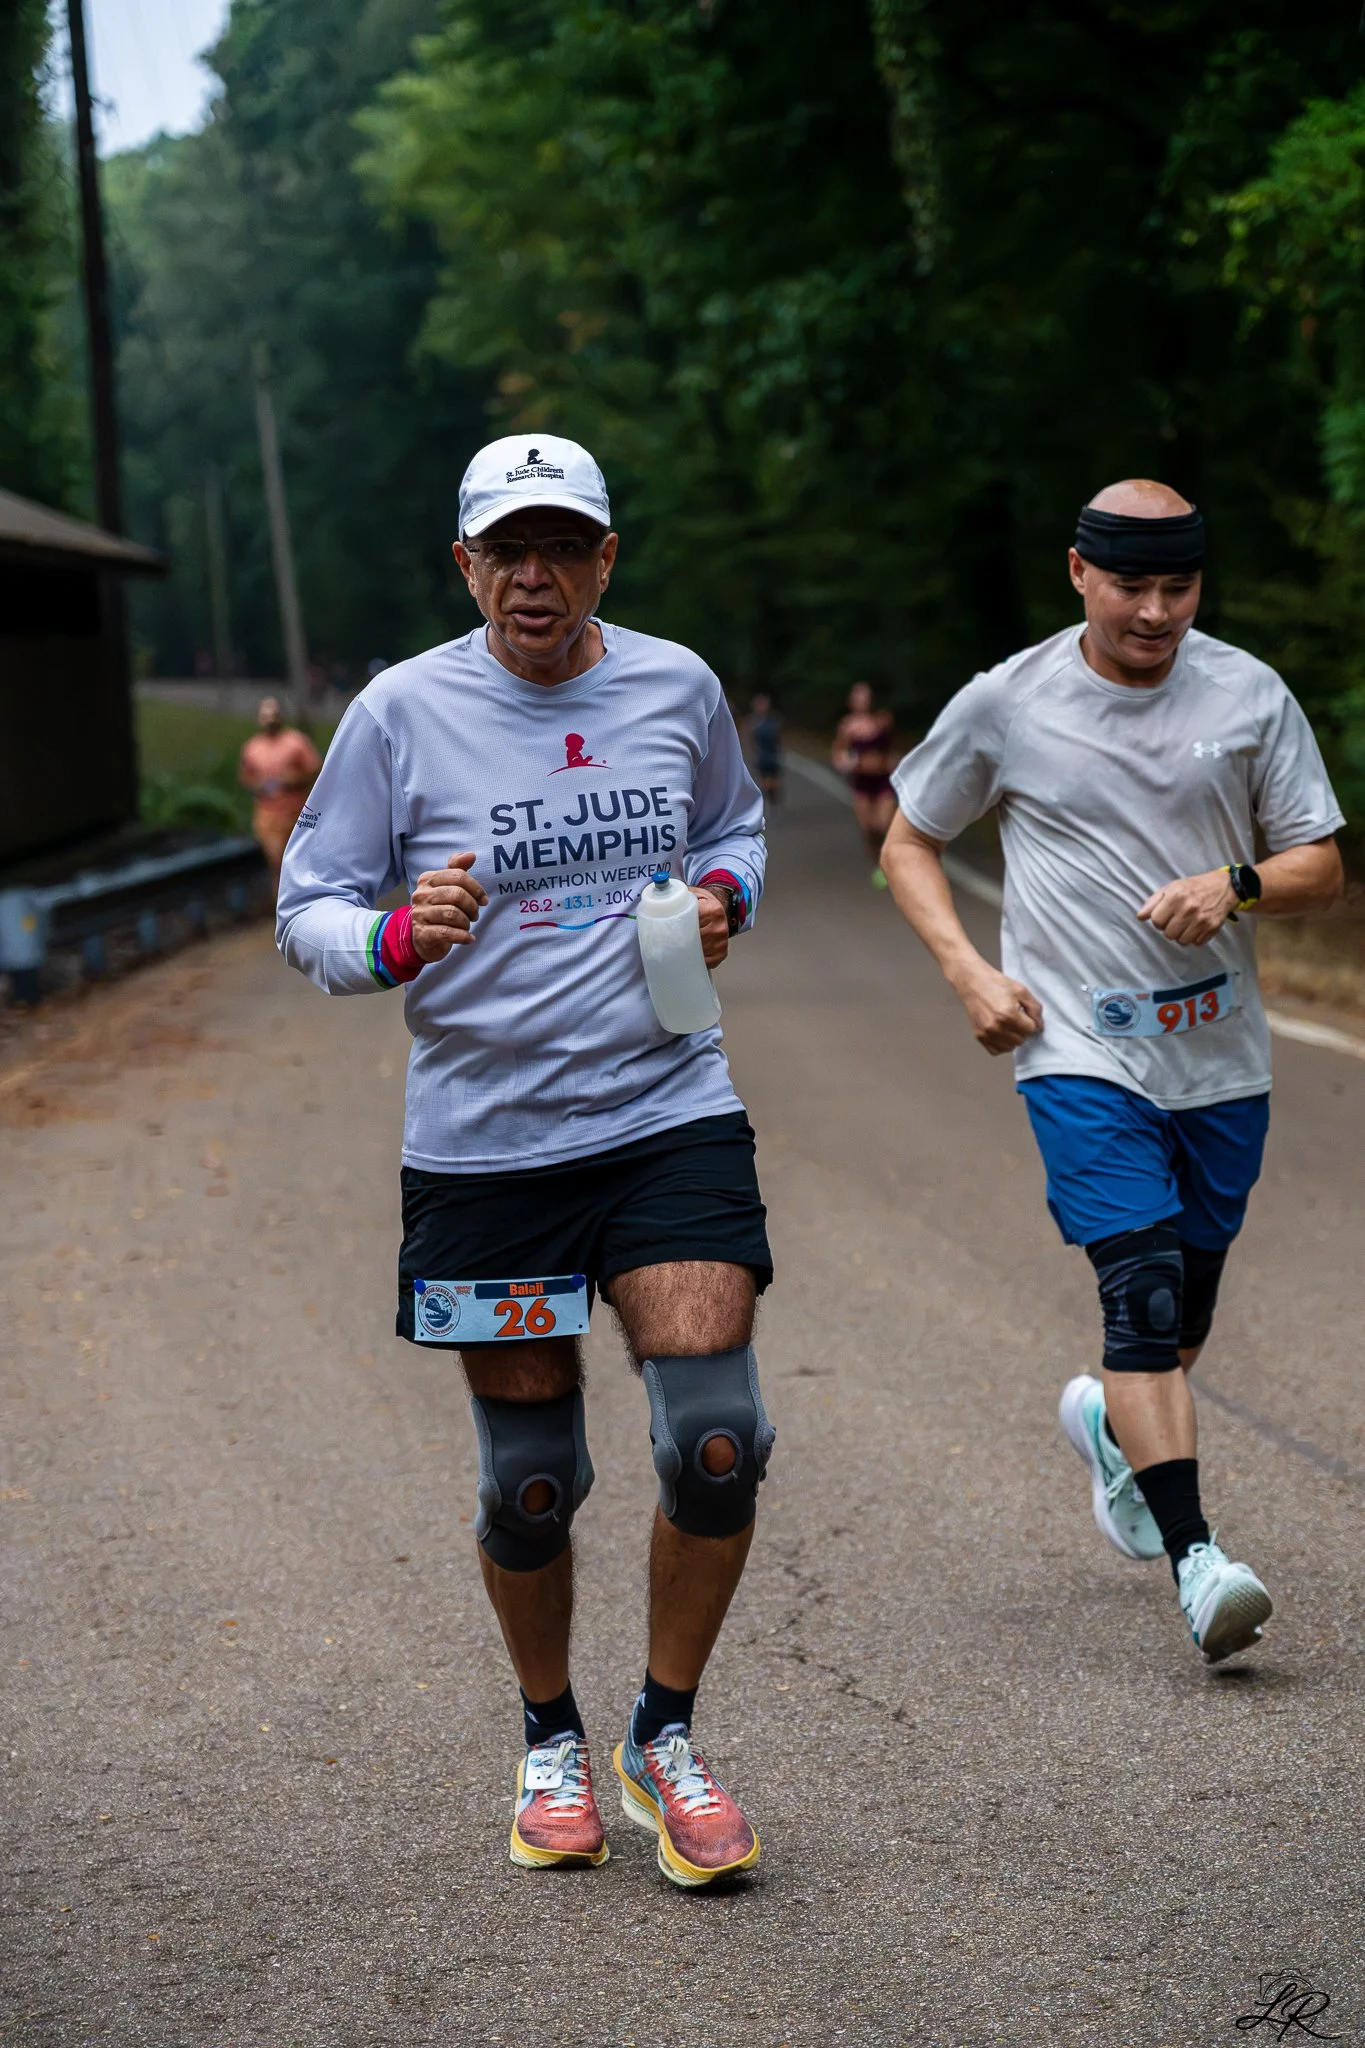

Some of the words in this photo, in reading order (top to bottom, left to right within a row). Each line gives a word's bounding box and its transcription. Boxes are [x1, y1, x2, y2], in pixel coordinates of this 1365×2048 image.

[506, 472, 536, 483] Research
[537, 472, 564, 480] Hospital
[515, 469, 530, 477] Jude
[490, 799, 552, 836] ST.
[563, 786, 672, 826] JUDE
[493, 824, 676, 874] MEMPHIS
[499, 872, 597, 895] MARATHON
[519, 898, 552, 913] 26.2
[564, 894, 594, 910] 13.1
[605, 888, 634, 905] 10K
[1157, 991, 1219, 1034] 913
[509, 1282, 544, 1297] Balaji
[494, 1297, 556, 1338] 26
